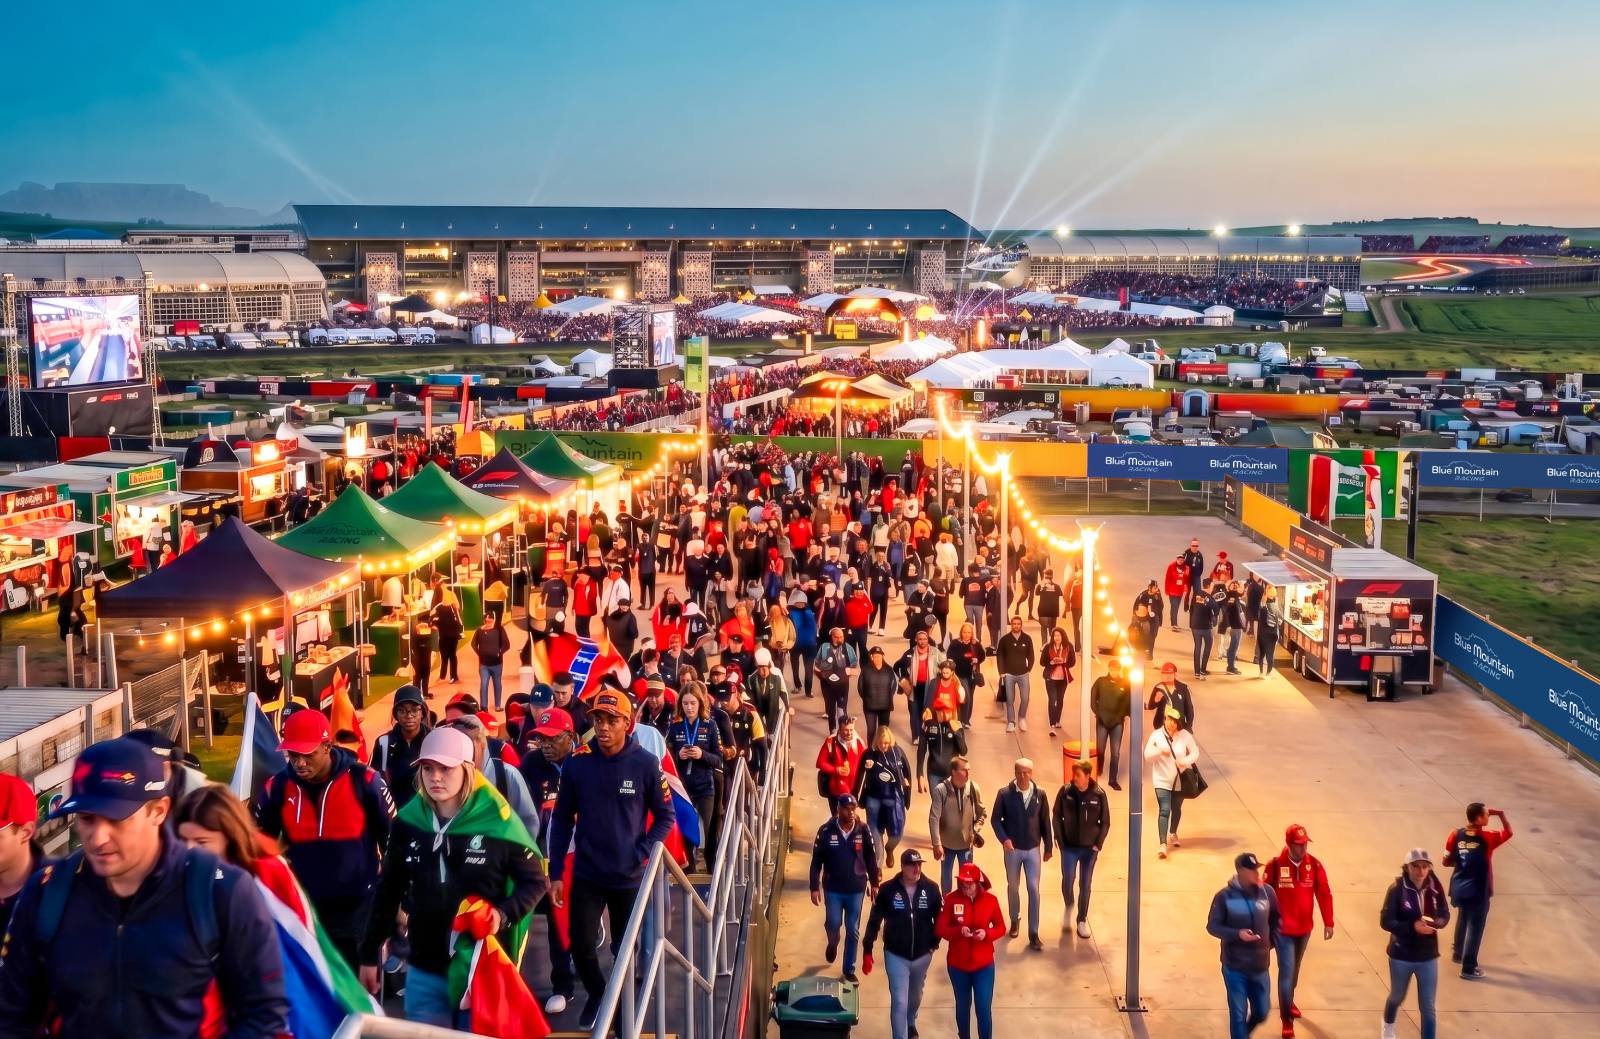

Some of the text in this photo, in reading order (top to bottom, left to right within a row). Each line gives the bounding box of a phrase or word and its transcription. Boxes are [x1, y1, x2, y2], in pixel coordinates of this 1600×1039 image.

[575, 446, 643, 461] ountain
[1105, 456, 1173, 467] Blue Mountain
[1209, 459, 1277, 470] Blue Mountain
[1431, 465, 1499, 476] Blue Mountain
[1546, 467, 1567, 477] Blue
[1454, 632, 1515, 680] Blue Mountain
[1473, 658, 1501, 680] RACING
[1548, 688, 1568, 711] Blue
[1569, 716, 1599, 741] RACING
